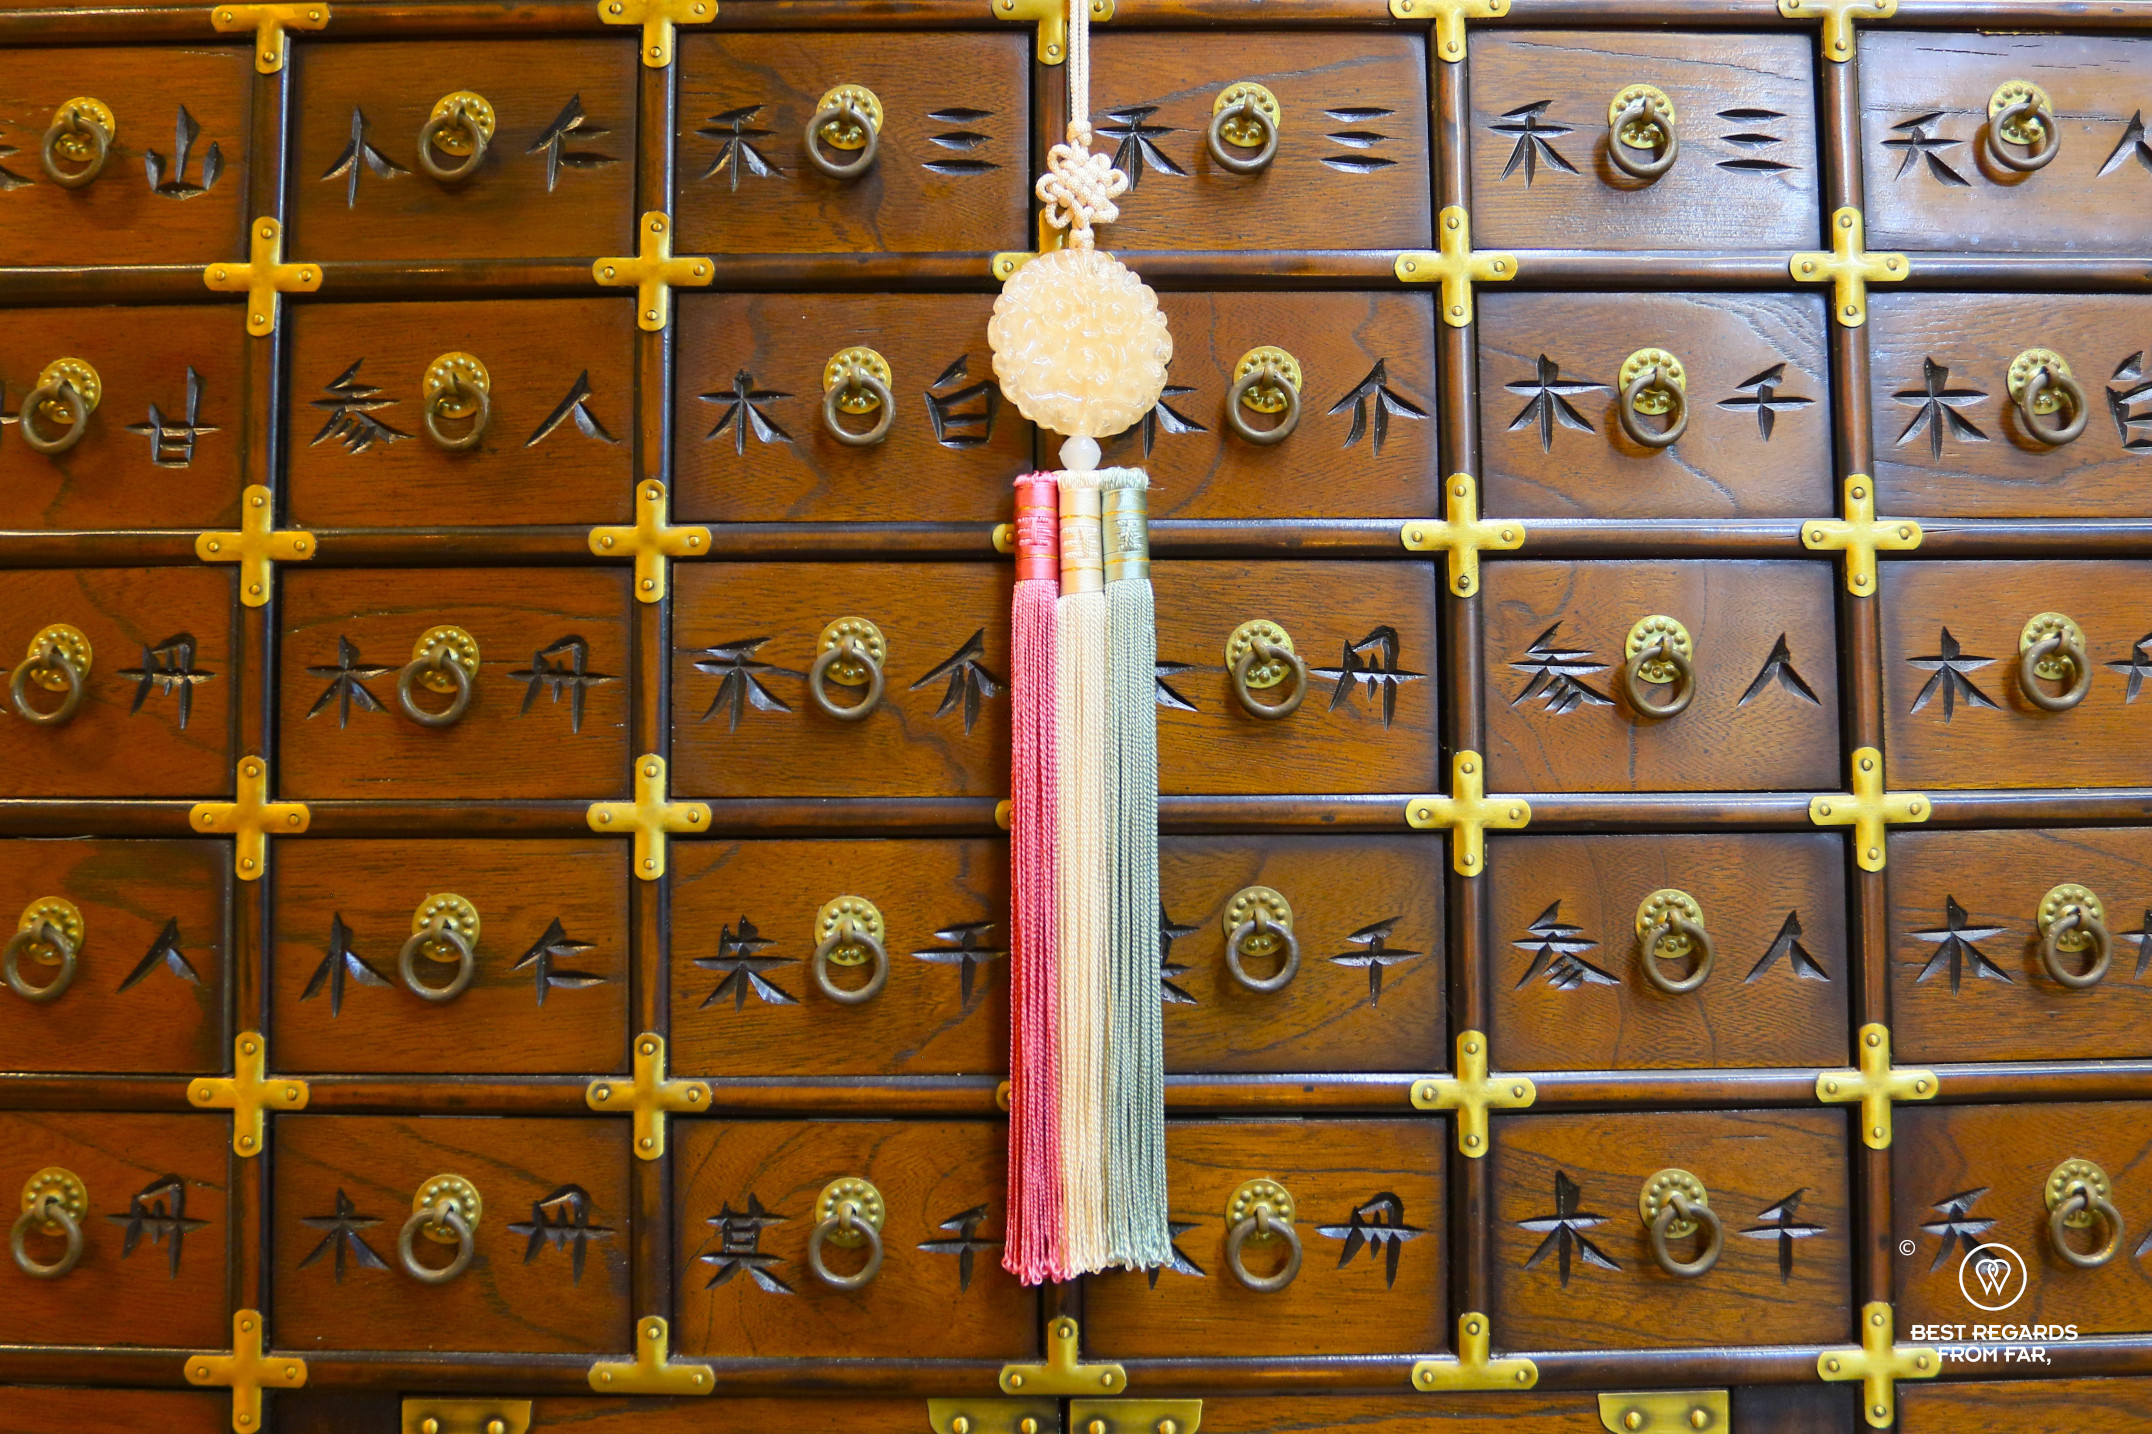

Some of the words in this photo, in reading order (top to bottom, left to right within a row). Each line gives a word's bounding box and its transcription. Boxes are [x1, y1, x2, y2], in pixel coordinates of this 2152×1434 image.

[145, 103, 225, 200] 山
[526, 93, 619, 193] 仁
[922, 106, 1002, 176] 三
[1320, 106, 1399, 174] 三
[1715, 107, 1802, 177] 三
[525, 369, 621, 449] 人
[925, 354, 996, 450] 白
[1328, 357, 1429, 458] 介
[910, 627, 1008, 735] 介
[1738, 632, 1821, 706] 人
[116, 916, 201, 994] 人
[512, 917, 609, 1007] 仁
[1745, 910, 1831, 983] 人
